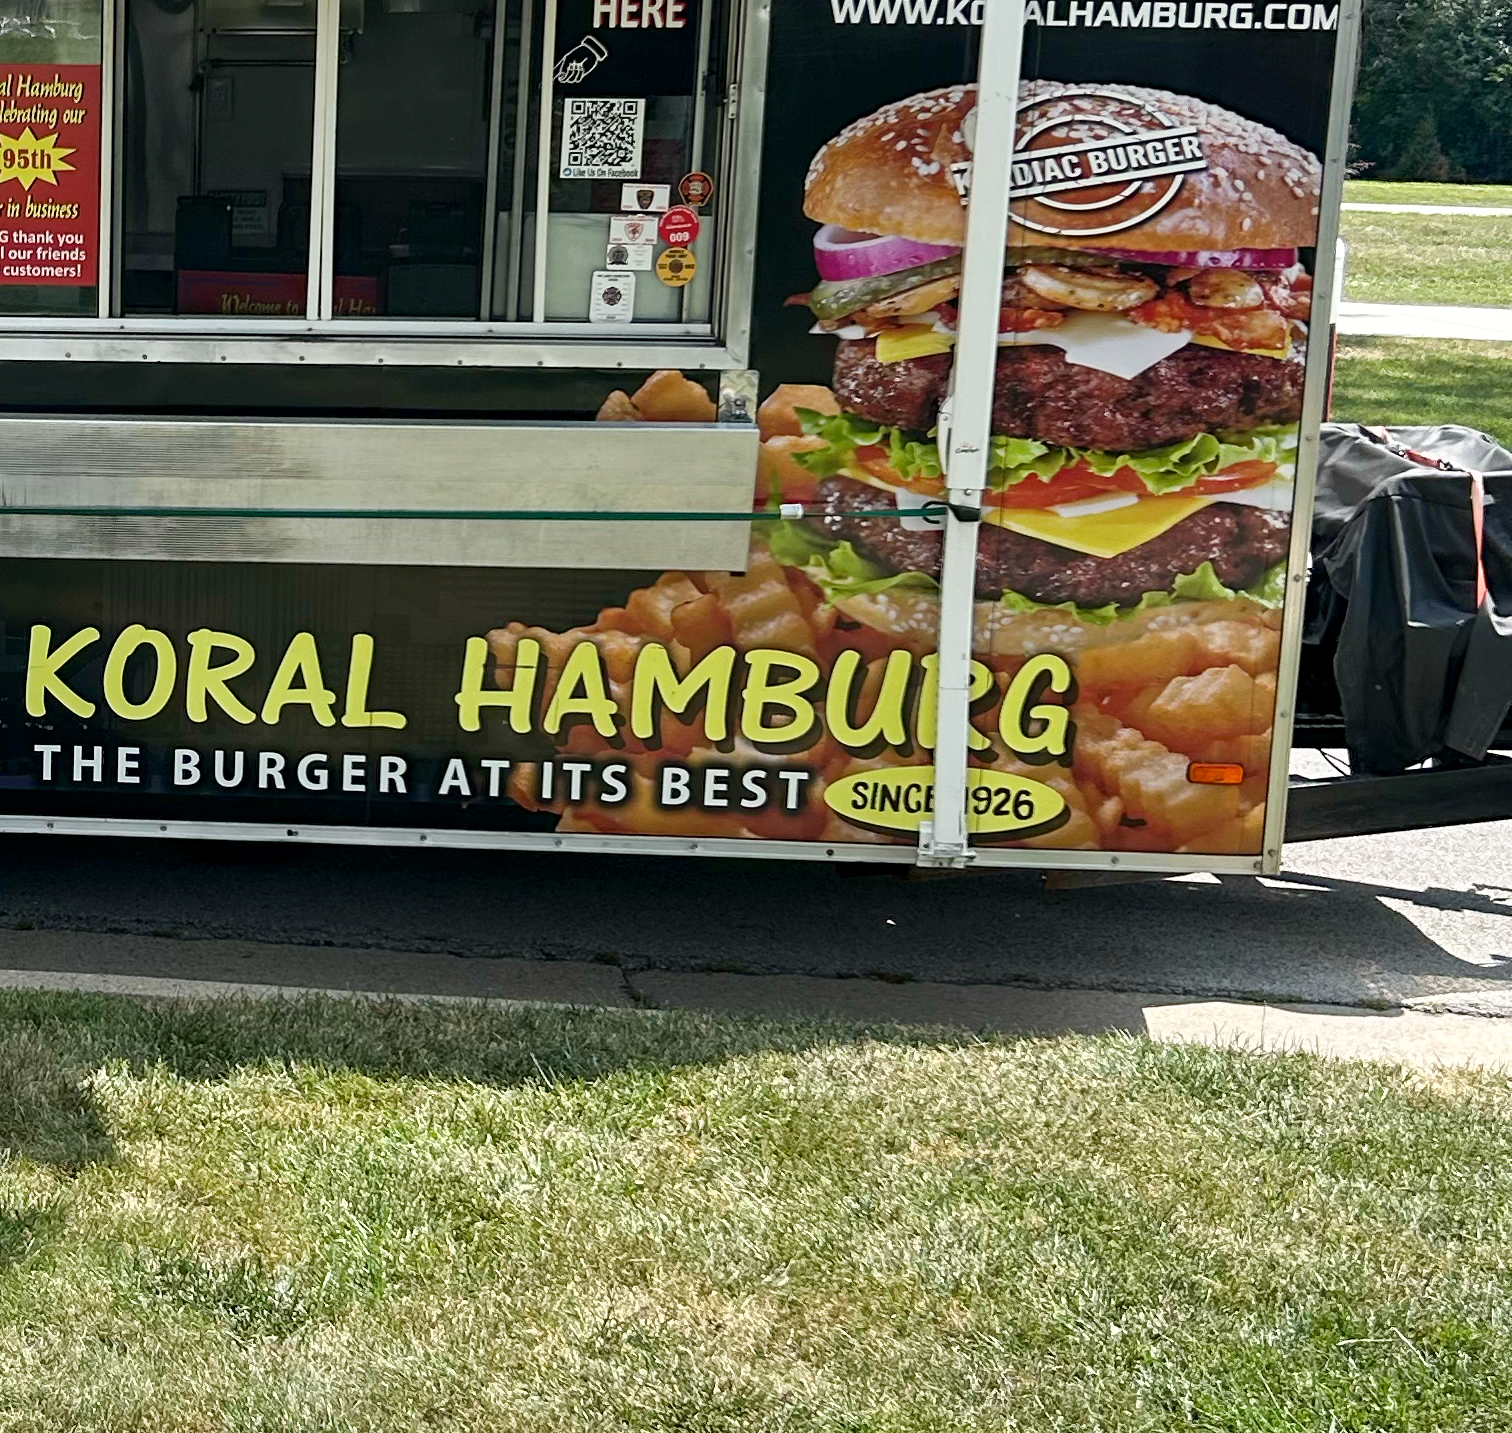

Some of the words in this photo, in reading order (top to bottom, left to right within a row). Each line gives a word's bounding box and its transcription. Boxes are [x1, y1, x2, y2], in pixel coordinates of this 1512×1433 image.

[16, 73, 83, 103] Hamburg
[63, 108, 86, 124] our
[2, 148, 52, 170] 95th
[1087, 135, 1204, 175] BURGER
[7, 197, 20, 218] in
[25, 194, 79, 219] business
[13, 230, 54, 244] thank
[56, 233, 84, 247] you
[8, 249, 33, 261] our
[36, 247, 86, 261] friends
[3, 263, 82, 278] customers!
[25, 623, 407, 728] KORAL
[454, 635, 1072, 756] HAMBURG
[34, 744, 141, 784] THE
[174, 748, 408, 794] BURGER
[438, 758, 511, 797] AT
[541, 761, 629, 803] ITS
[661, 766, 810, 810] BEST
[966, 785, 1035, 821] 1926
